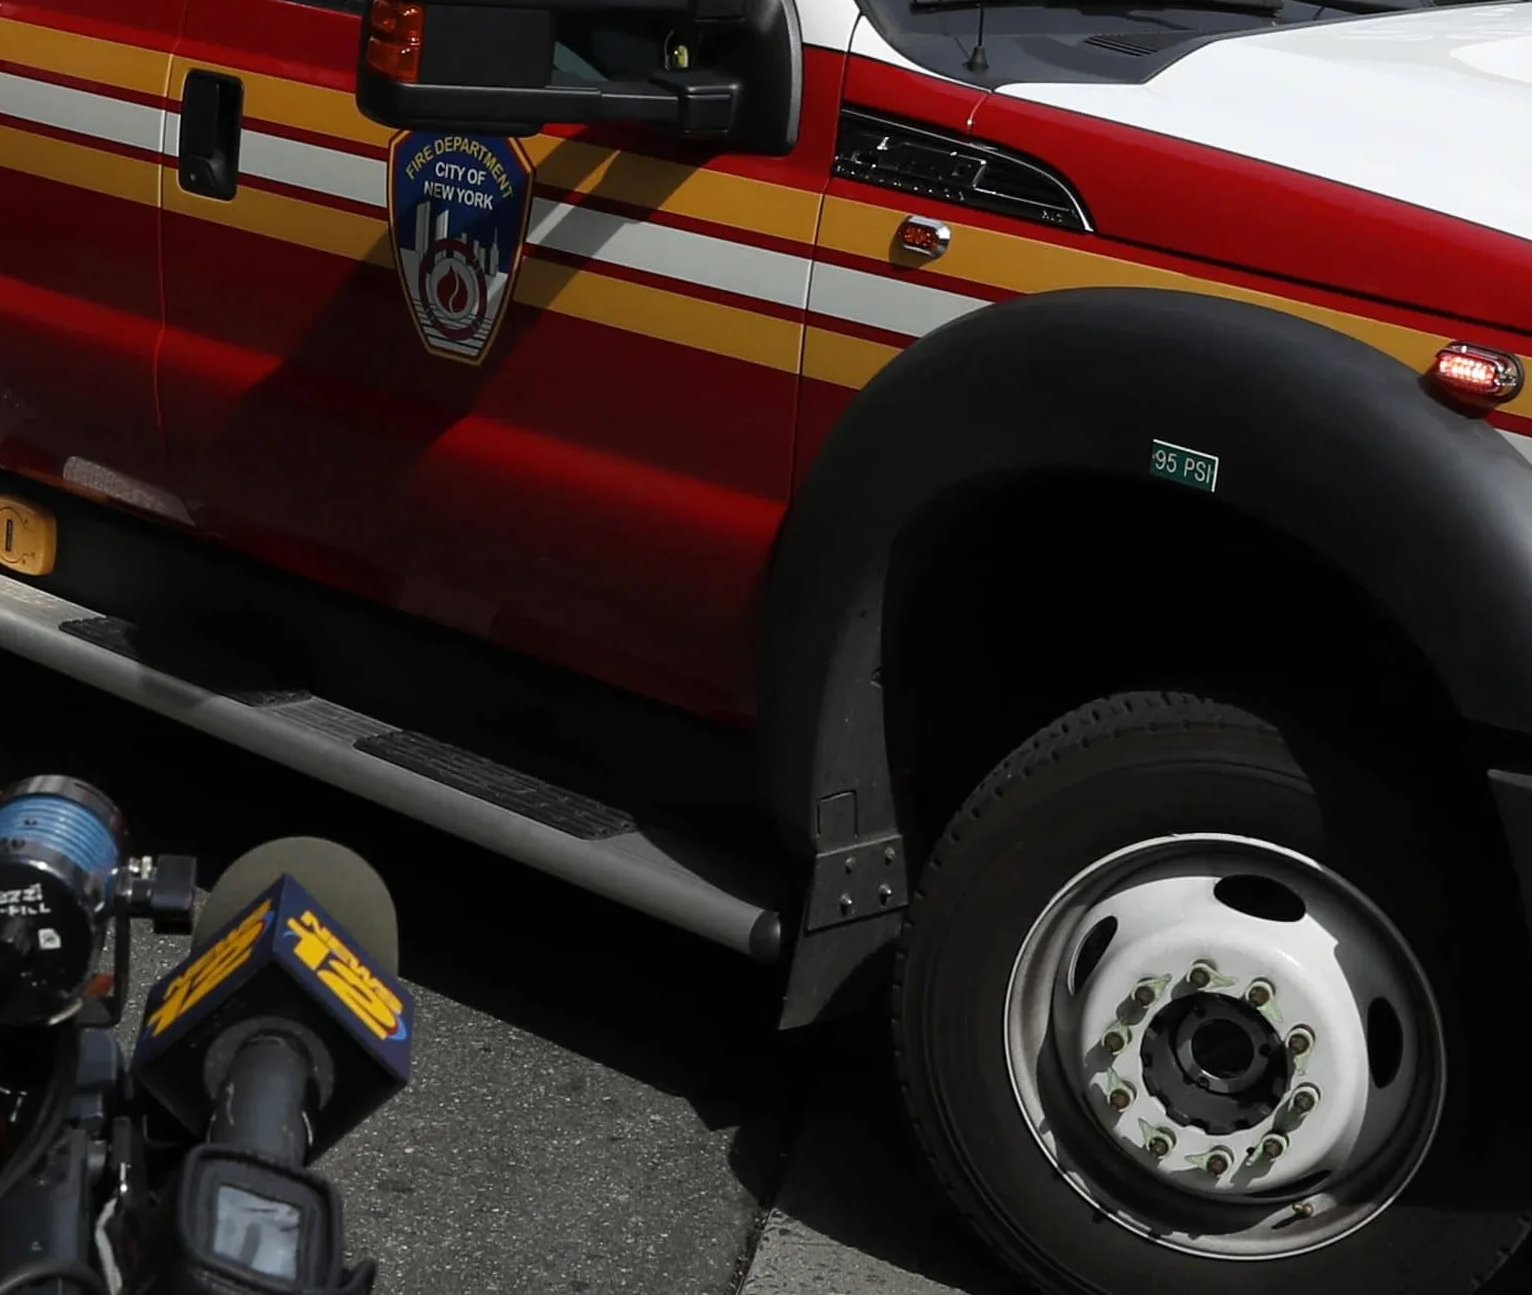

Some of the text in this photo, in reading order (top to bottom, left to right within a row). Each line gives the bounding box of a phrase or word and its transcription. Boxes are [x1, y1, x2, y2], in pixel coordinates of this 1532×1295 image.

[405, 136, 515, 199] FIRE DEPARTMENT
[434, 160, 488, 185] CITY OF
[423, 181, 494, 211] NEW YORK
[1154, 449, 1212, 485] 95 PSI
[286, 917, 398, 1041] 12
[299, 909, 404, 1014] NEWS
